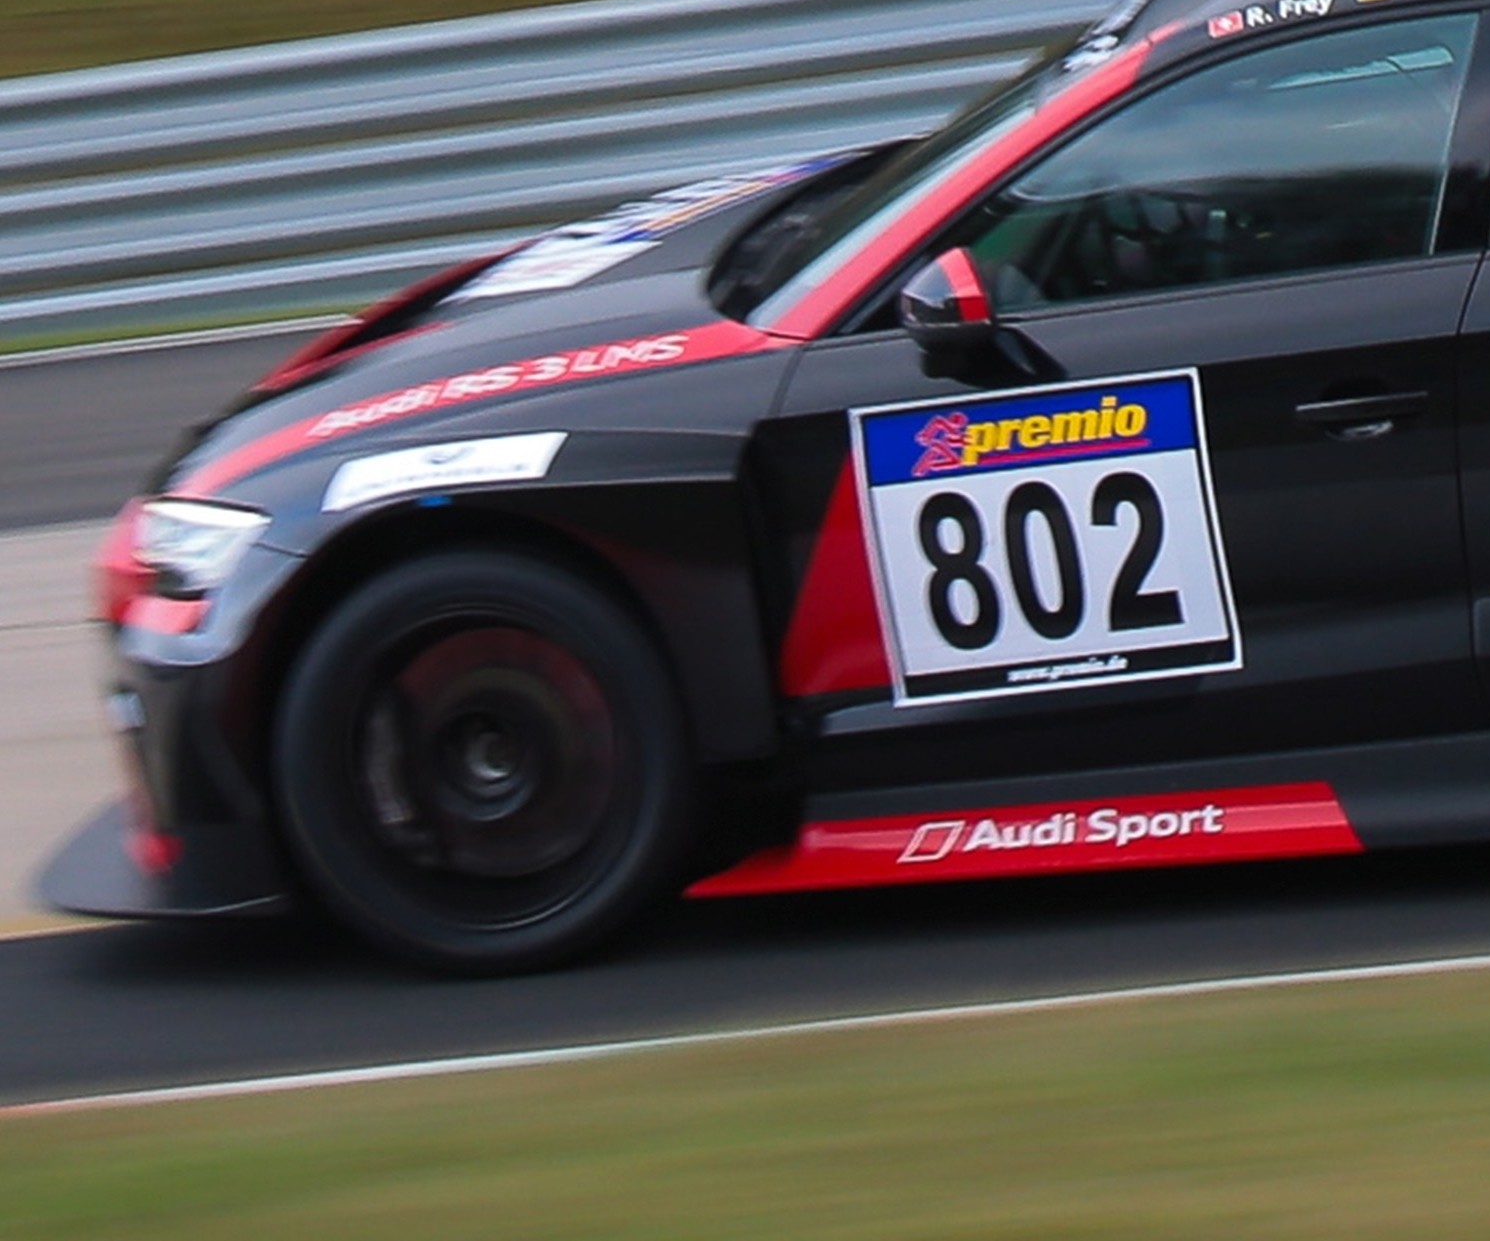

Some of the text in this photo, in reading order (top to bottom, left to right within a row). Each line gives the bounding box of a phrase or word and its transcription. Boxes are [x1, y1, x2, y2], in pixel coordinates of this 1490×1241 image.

[1245, 6, 1274, 28] R.
[442, 364, 523, 400] RS
[962, 395, 1147, 466] premio
[918, 470, 1185, 651] 802
[962, 803, 1225, 852] Audi Sport
